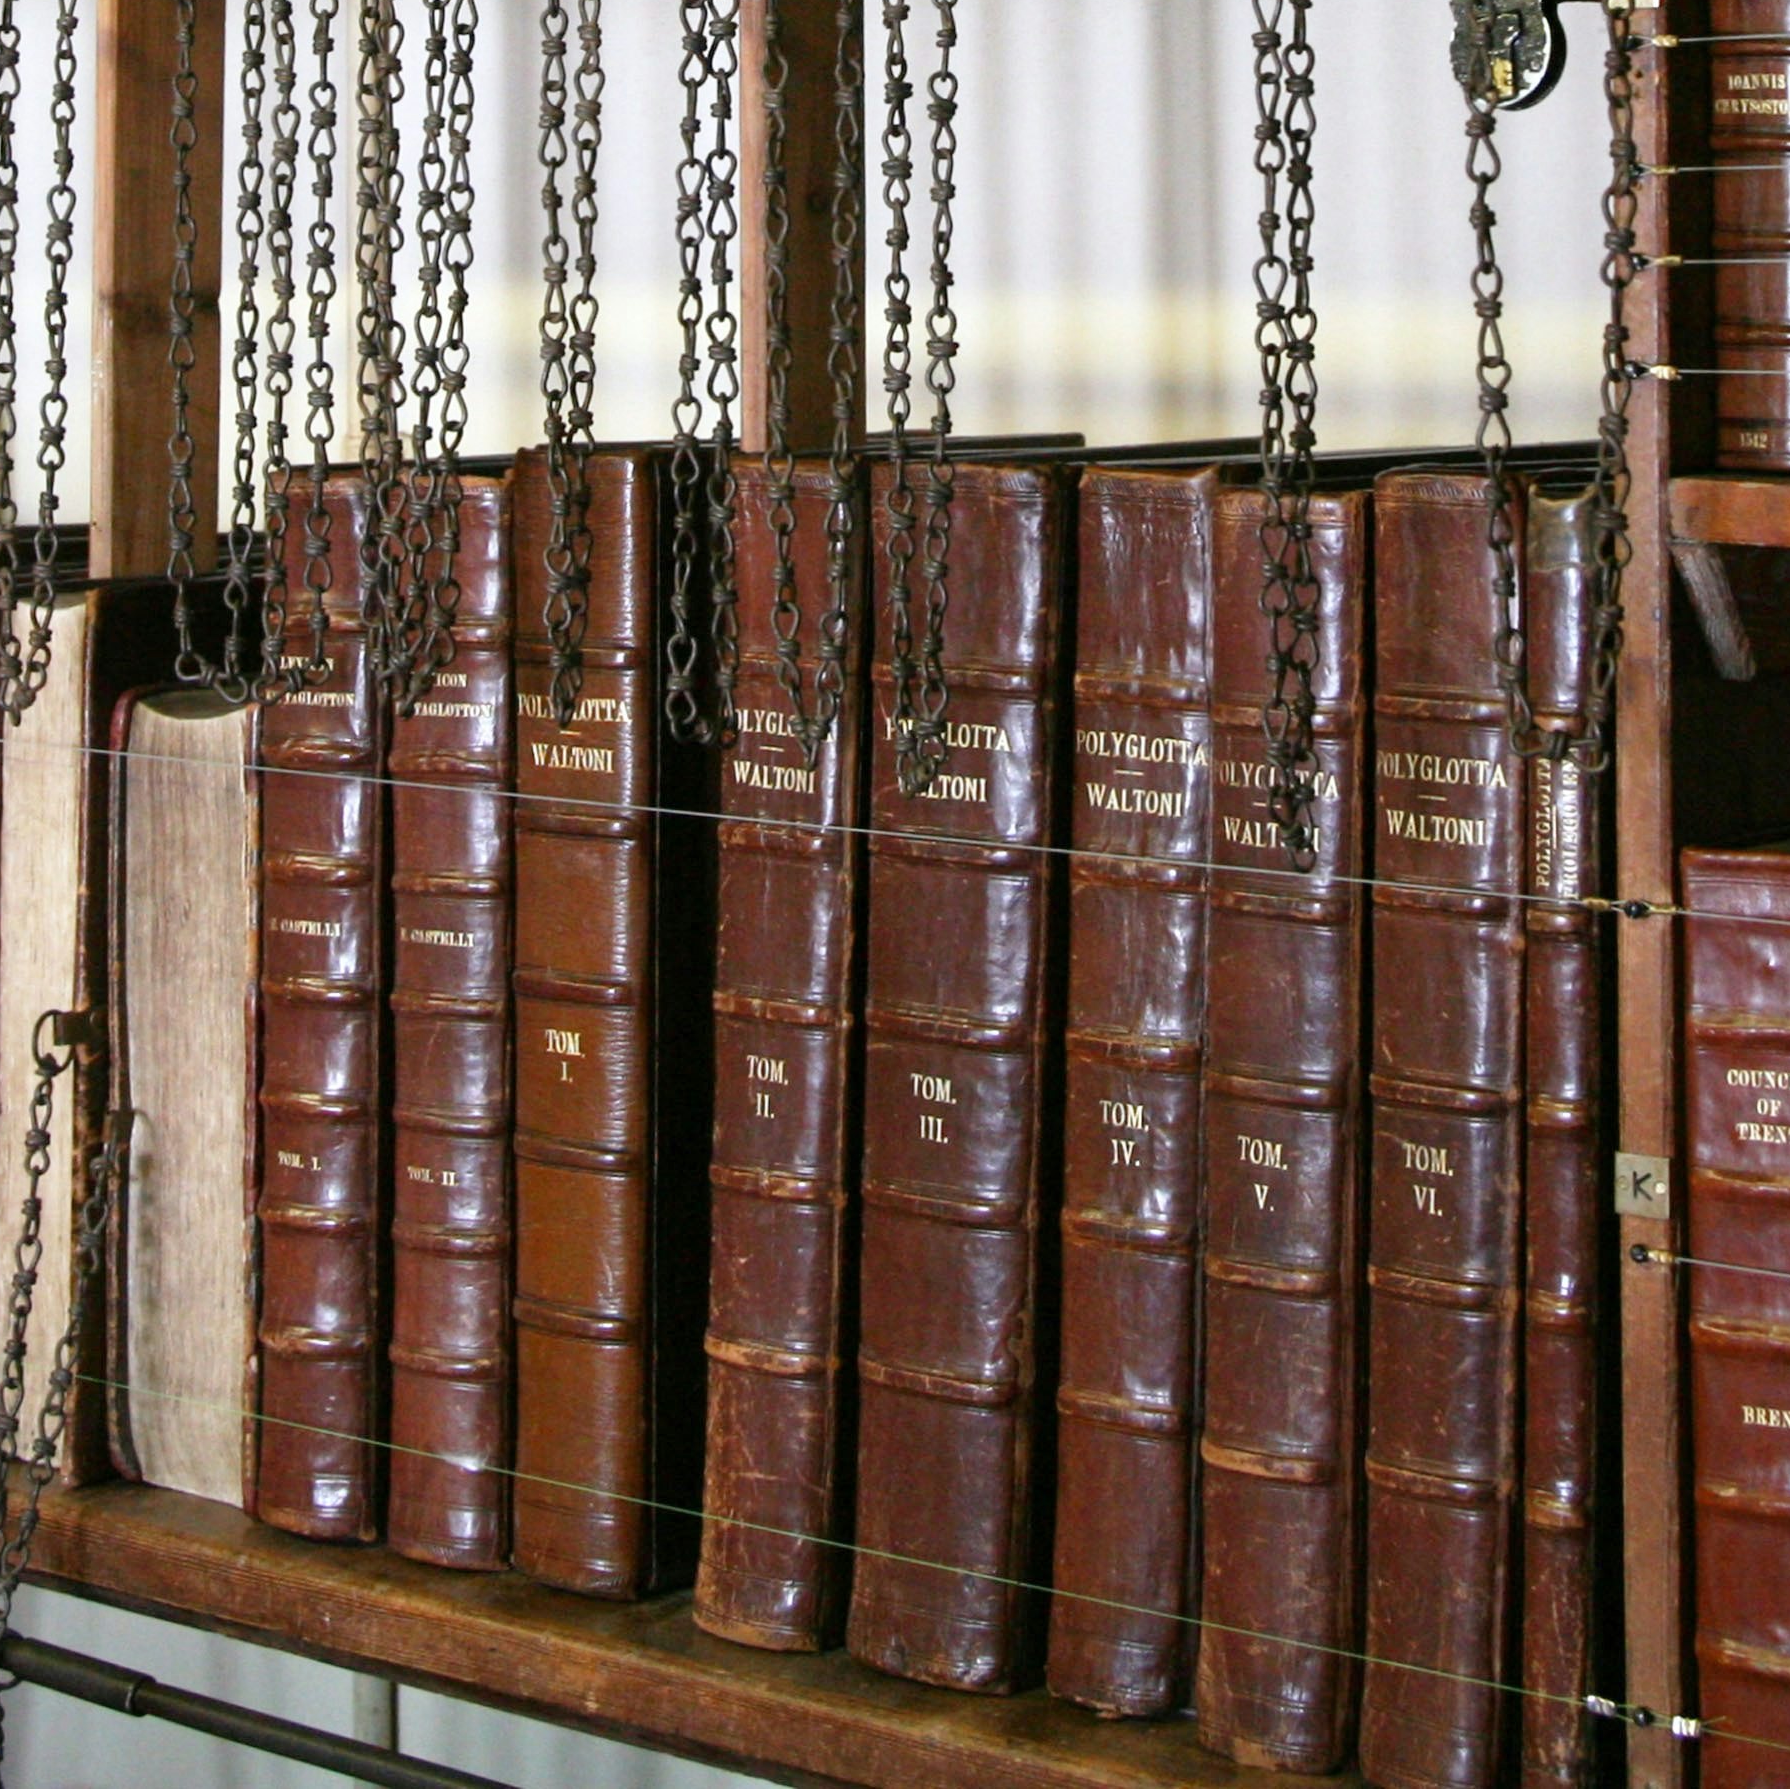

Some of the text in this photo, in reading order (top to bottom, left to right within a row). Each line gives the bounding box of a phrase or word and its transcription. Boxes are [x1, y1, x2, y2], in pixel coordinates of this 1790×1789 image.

[1727, 74, 1786, 91] IOANNIS
[531, 742, 615, 774] WALTONI
[1075, 728, 1209, 768] POLYGLOTTA
[733, 759, 817, 794] WALTONI
[1376, 749, 1508, 789] POLYGLOTTA
[1086, 782, 1183, 818] WALTONI
[1223, 814, 1320, 854] WALTI
[1386, 808, 1487, 848] WALTONI
[280, 918, 342, 939] CASTELLI
[409, 928, 475, 949] CASTELLI
[546, 1029, 586, 1058] TOM.
[746, 1053, 791, 1086] TOM.
[910, 1072, 958, 1106] TOM.
[756, 1092, 776, 1120] II.
[1099, 1099, 1150, 1133] TOM.
[1756, 1097, 1782, 1118] OF
[919, 1113, 950, 1146] III.
[1111, 1139, 1142, 1168] IV.
[1237, 1135, 1289, 1171] TOM.
[1402, 1141, 1454, 1178] TOM.
[441, 1169, 460, 1188] II.
[1630, 1169, 1653, 1202] K
[1253, 1182, 1275, 1213] V.
[1413, 1182, 1444, 1218] VI.
